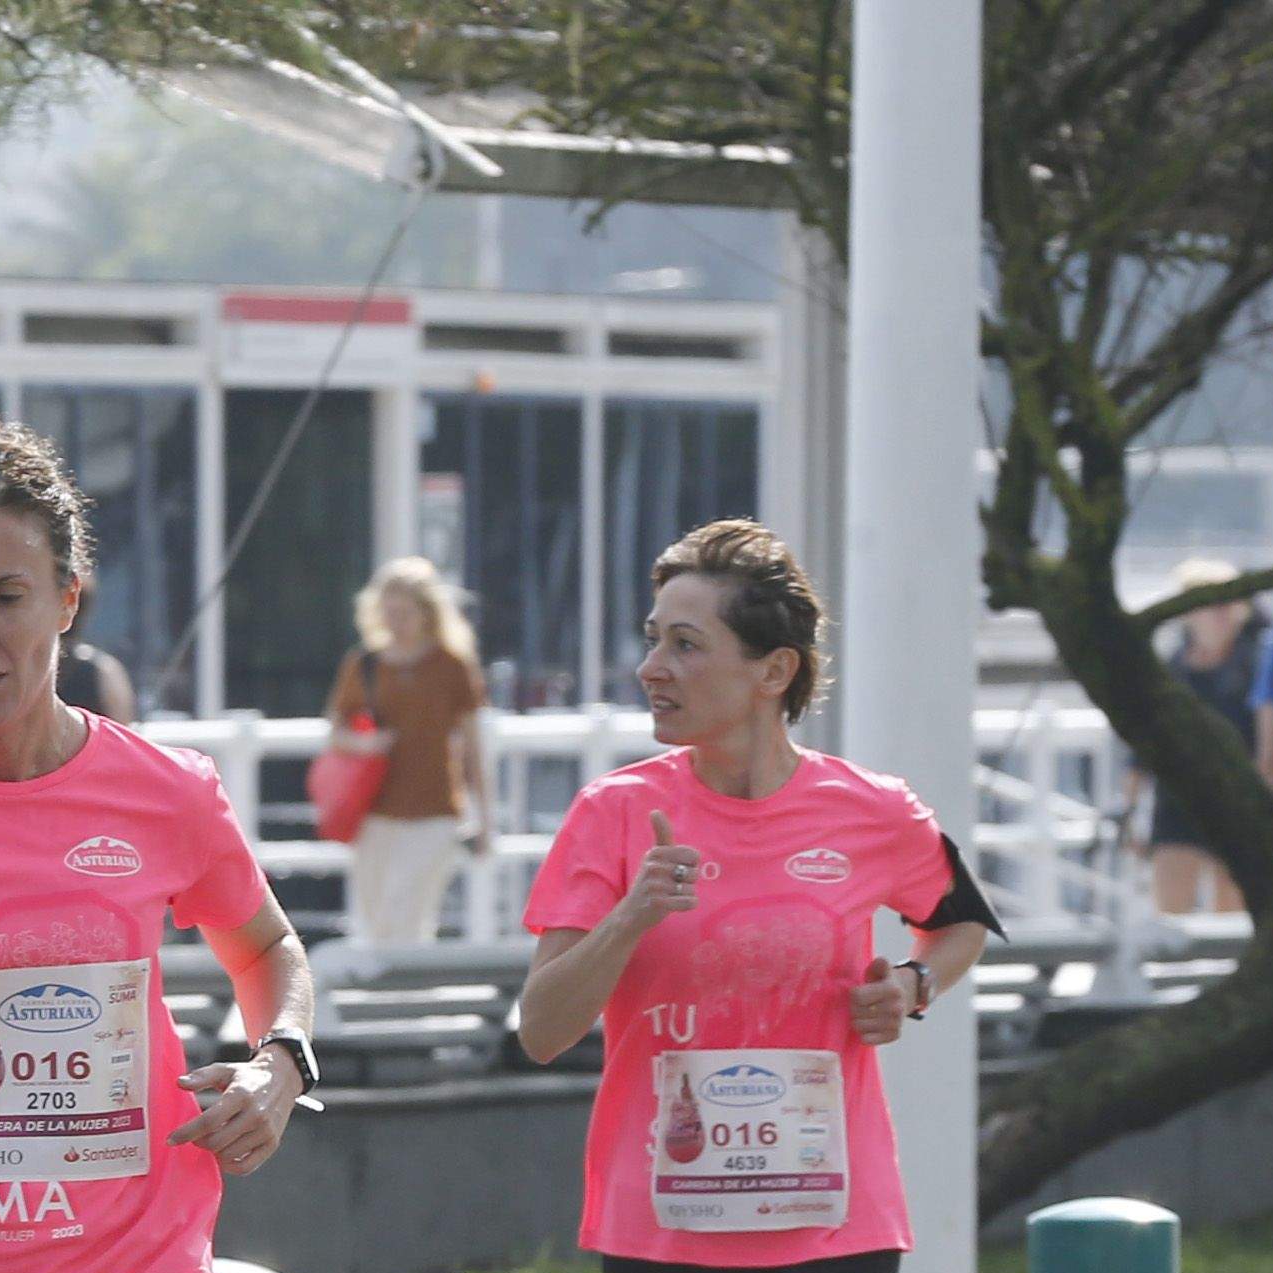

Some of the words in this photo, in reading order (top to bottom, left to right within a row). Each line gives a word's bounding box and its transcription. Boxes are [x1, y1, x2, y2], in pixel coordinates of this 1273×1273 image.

[73, 853, 138, 868] ASTURIANA
[108, 991, 138, 1005] SUMA
[6, 1003, 95, 1021] ASTURIANA
[643, 1003, 697, 1044] TU
[11, 1051, 92, 1081] 016
[27, 1092, 77, 1110] 2703
[25, 1120, 45, 1132] DE
[47, 1120, 66, 1132] LA
[67, 1118, 111, 1131] MUJER
[711, 1122, 778, 1146] 016
[82, 1144, 140, 1162] Santander
[724, 1155, 767, 1171] 4639
[742, 1179, 758, 1189] LA
[51, 1224, 85, 1239] 2023
